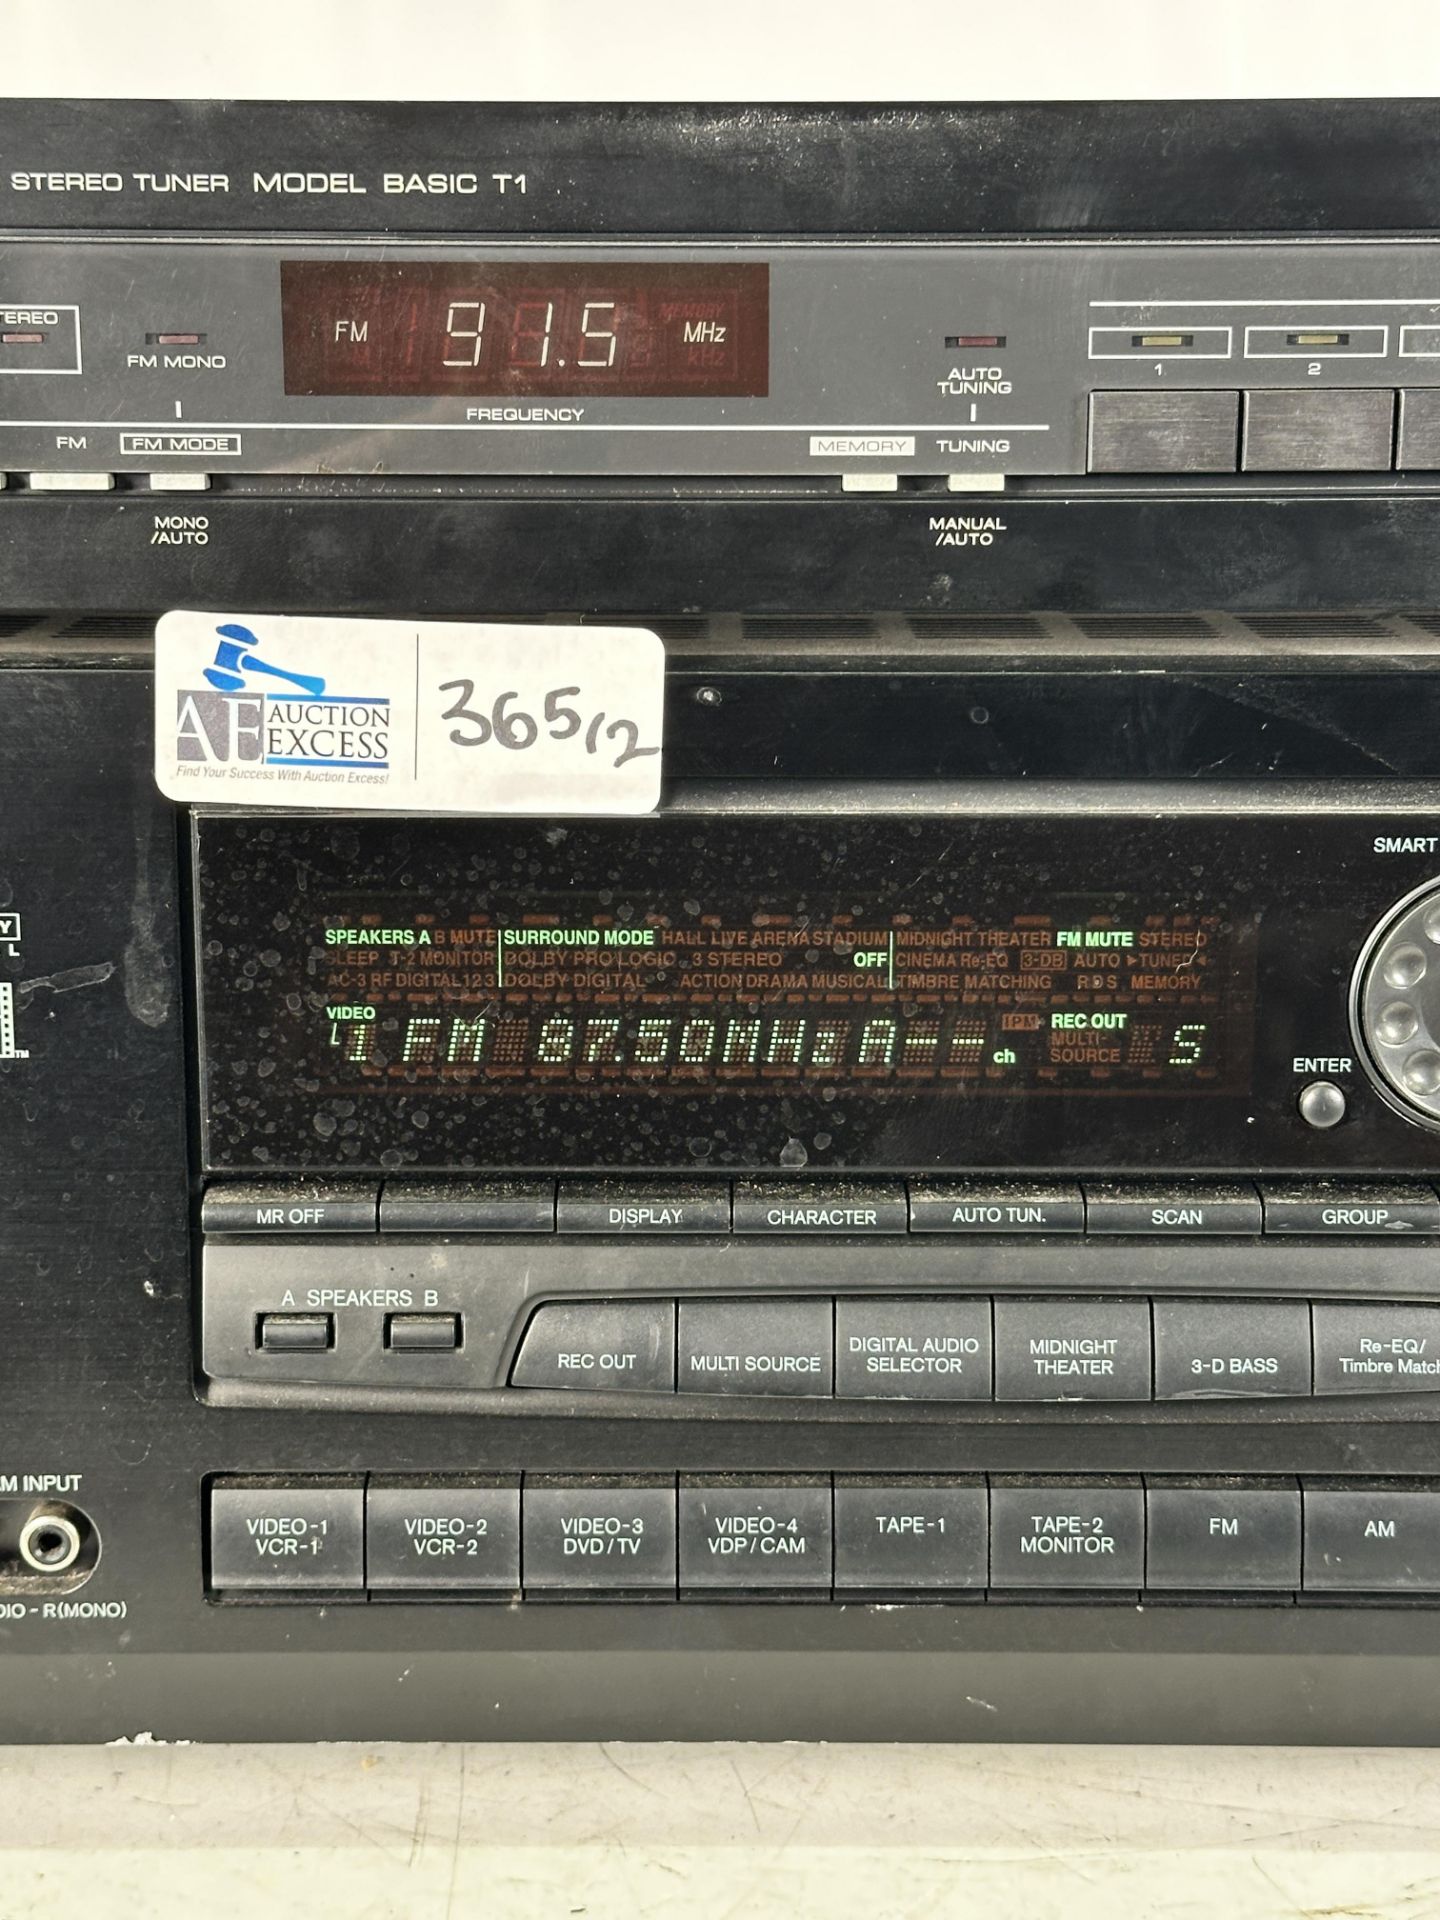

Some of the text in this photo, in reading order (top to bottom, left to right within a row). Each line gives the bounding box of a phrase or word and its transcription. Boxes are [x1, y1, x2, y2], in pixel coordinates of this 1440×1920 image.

[11, 172, 528, 195] STEREO TUNER MODEL BASIC T1
[335, 302, 727, 367] FM 91.5 MHz
[127, 355, 226, 369] FM MONO
[1154, 363, 1164, 375] 1
[1307, 363, 1322, 375] 2
[947, 367, 1002, 381] AUTO
[936, 381, 1012, 395] TUNING
[466, 407, 584, 422] FREQUENCY
[56, 436, 87, 450] FM
[132, 437, 229, 451] FM MODE
[817, 439, 906, 453] MEMORY
[936, 439, 1010, 453] TUNING
[154, 516, 209, 530] MONO
[929, 517, 1007, 531] MANUAL
[151, 530, 209, 545] /AUTO
[935, 532, 994, 546] /AUTO
[267, 703, 390, 727] AUCTION
[267, 728, 389, 760] EXCESS
[176, 764, 390, 785] Find Your Success With Auction Excess!
[1373, 837, 1438, 853] SMART
[325, 929, 415, 945] SPEAKERS
[418, 930, 432, 945] A
[450, 930, 497, 944] MUTE
[503, 930, 888, 945] SURROUND MODE HALL LIVE ARENA STADIUM
[896, 931, 1207, 947] MIDNIGHT THEATER FM MUTE STEREO
[325, 951, 379, 966] SLEEP
[420, 951, 494, 966] MONITOR
[505, 951, 567, 966] DOLBY
[708, 952, 783, 966] STEREO
[853, 952, 888, 967] OFF
[895, 953, 956, 968] CINEMA
[960, 953, 1009, 968] Re-EQ
[1074, 953, 1120, 968] AUTO
[371, 973, 391, 988] RF
[505, 973, 886, 989] DOLBY DIGITAL ACTION DRAMA MUSICAL
[897, 975, 960, 989] TIMBRE
[964, 975, 1052, 989] MATCHING
[1131, 975, 1201, 989] MEMORY
[326, 1006, 376, 1020] VIDEO
[1051, 1013, 1127, 1028] REC OUT
[402, 1018, 486, 1062] FM
[992, 1049, 1016, 1063] ch
[1050, 1049, 1121, 1063] SOURCE
[1292, 1057, 1352, 1073] ENTER
[256, 1209, 325, 1224] MR OFF
[608, 1208, 683, 1225] DISPLAY
[766, 1209, 877, 1226] CHARACTER
[951, 1206, 1047, 1224] AUTO TUN.
[1150, 1209, 1203, 1225] SCAN
[1321, 1208, 1389, 1225] GROUP
[281, 1290, 438, 1307] A SPEAKERS B
[849, 1336, 980, 1354] DIGITAL AUDIO
[1028, 1338, 1118, 1356] MIDNIGHT
[1359, 1338, 1427, 1355] Re-EQ/
[557, 1353, 637, 1369] REC OUT
[690, 1355, 821, 1373] MULTI SOURCE
[866, 1357, 963, 1374] SELECTOR
[1033, 1358, 1114, 1375] THEATER
[1190, 1358, 1278, 1374] 3-D BASS
[1338, 1357, 1394, 1374] Timbre
[22, 1474, 83, 1492] INPUT
[245, 1518, 327, 1536] VIDEO-1
[403, 1518, 488, 1536] VIDEO-2
[560, 1517, 644, 1535] VIDEO-3
[715, 1517, 798, 1534] VIDEO-4
[875, 1517, 946, 1534] TAPE-1
[1030, 1517, 1104, 1534] TAPE-2
[1208, 1519, 1238, 1535] FM
[1363, 1520, 1395, 1537] AM
[254, 1538, 319, 1556] VCR-1
[412, 1538, 479, 1556] VCR-2
[1019, 1536, 1115, 1554] MONITOR
[43, 1601, 128, 1620] R(MONO)
